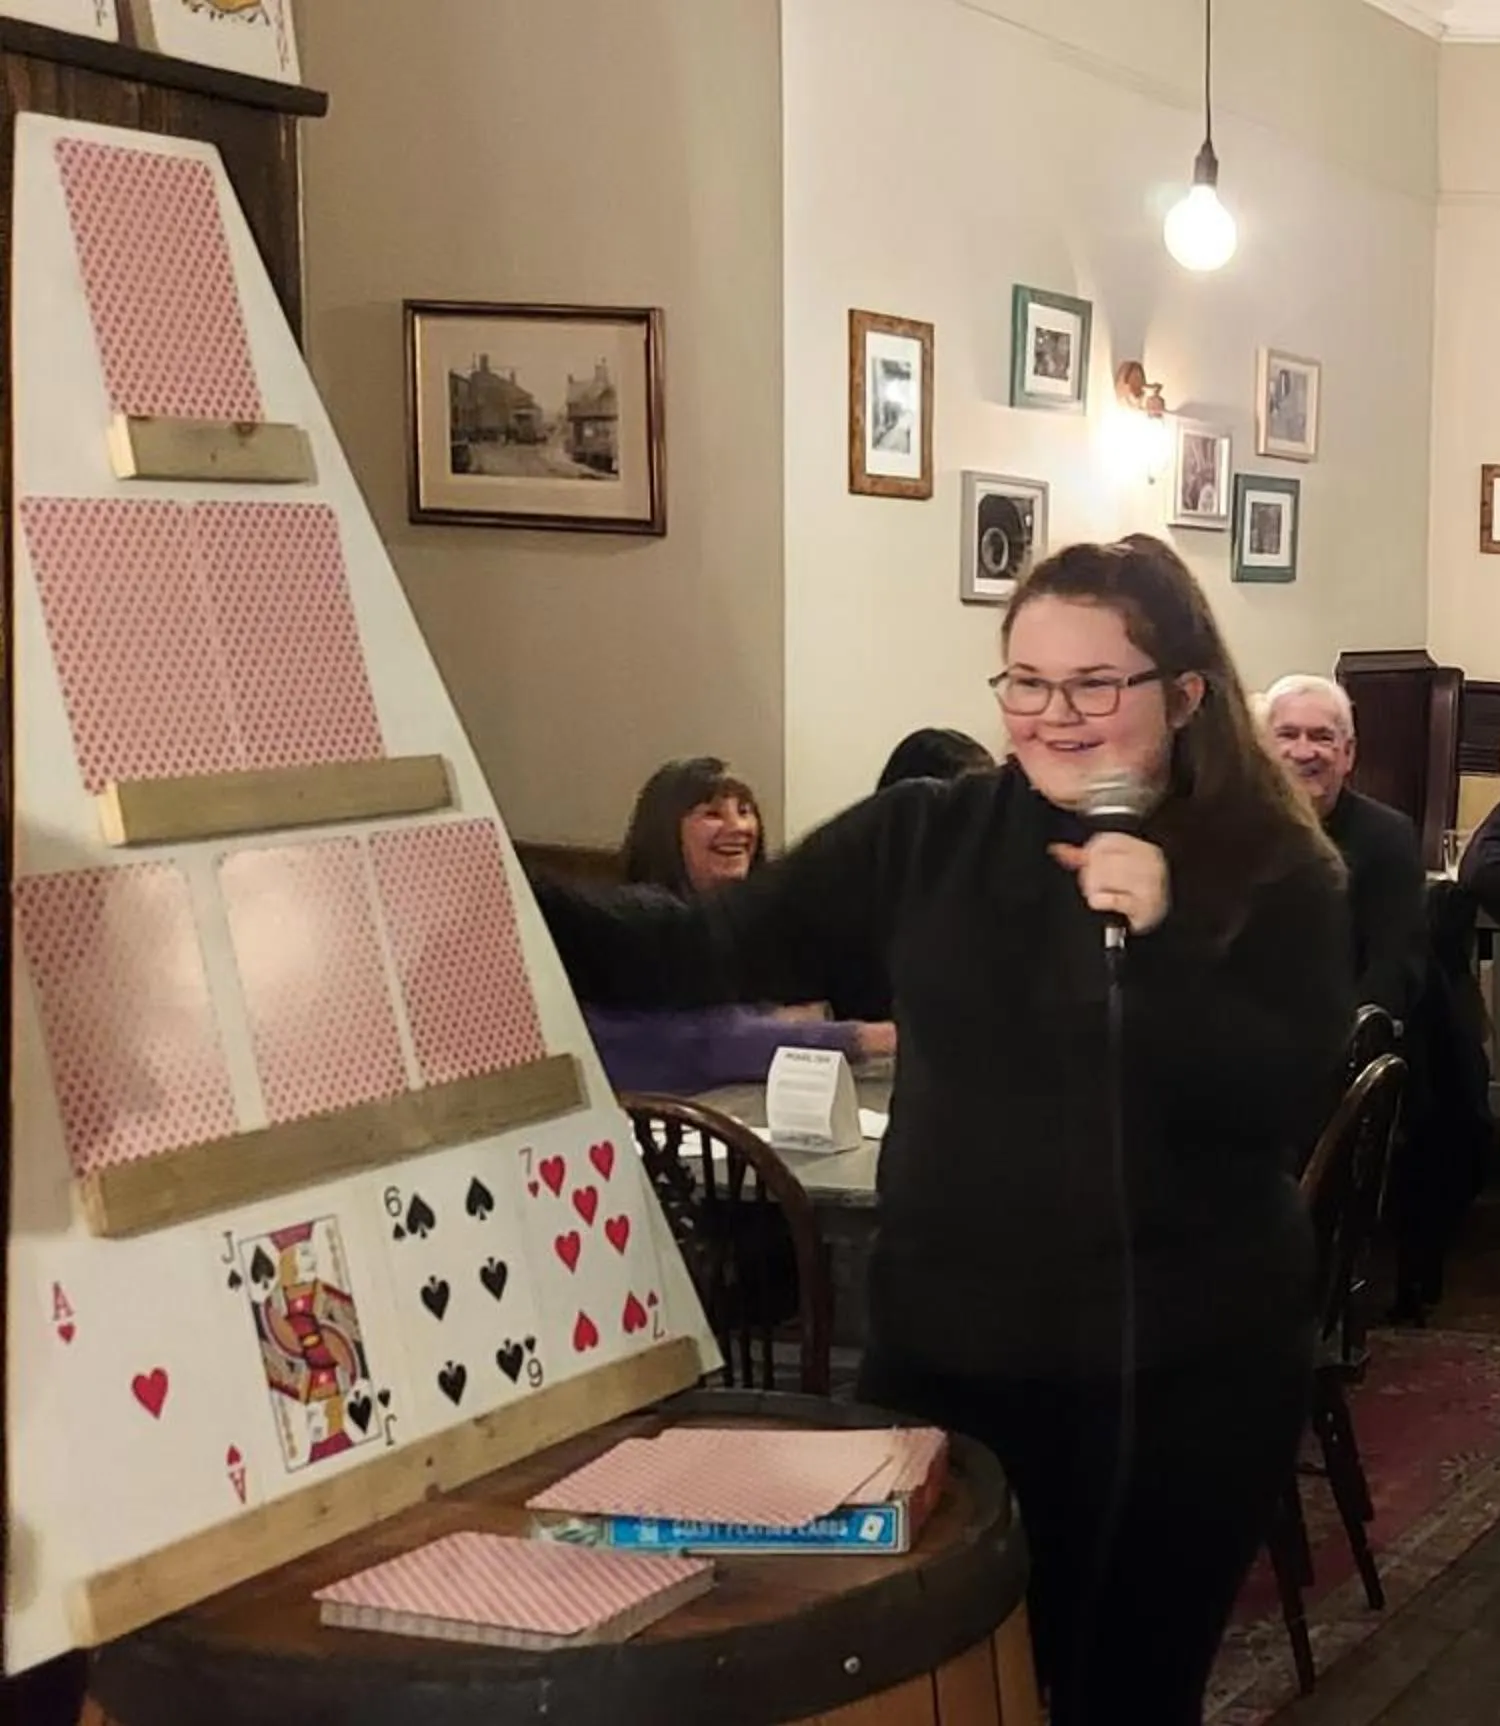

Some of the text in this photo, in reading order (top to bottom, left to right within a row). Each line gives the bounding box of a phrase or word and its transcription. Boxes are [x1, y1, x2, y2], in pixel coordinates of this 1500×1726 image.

[383, 1185, 403, 1217] 6
[221, 1231, 235, 1264] J
[52, 1281, 76, 1321] A
[228, 1467, 247, 1504] A
